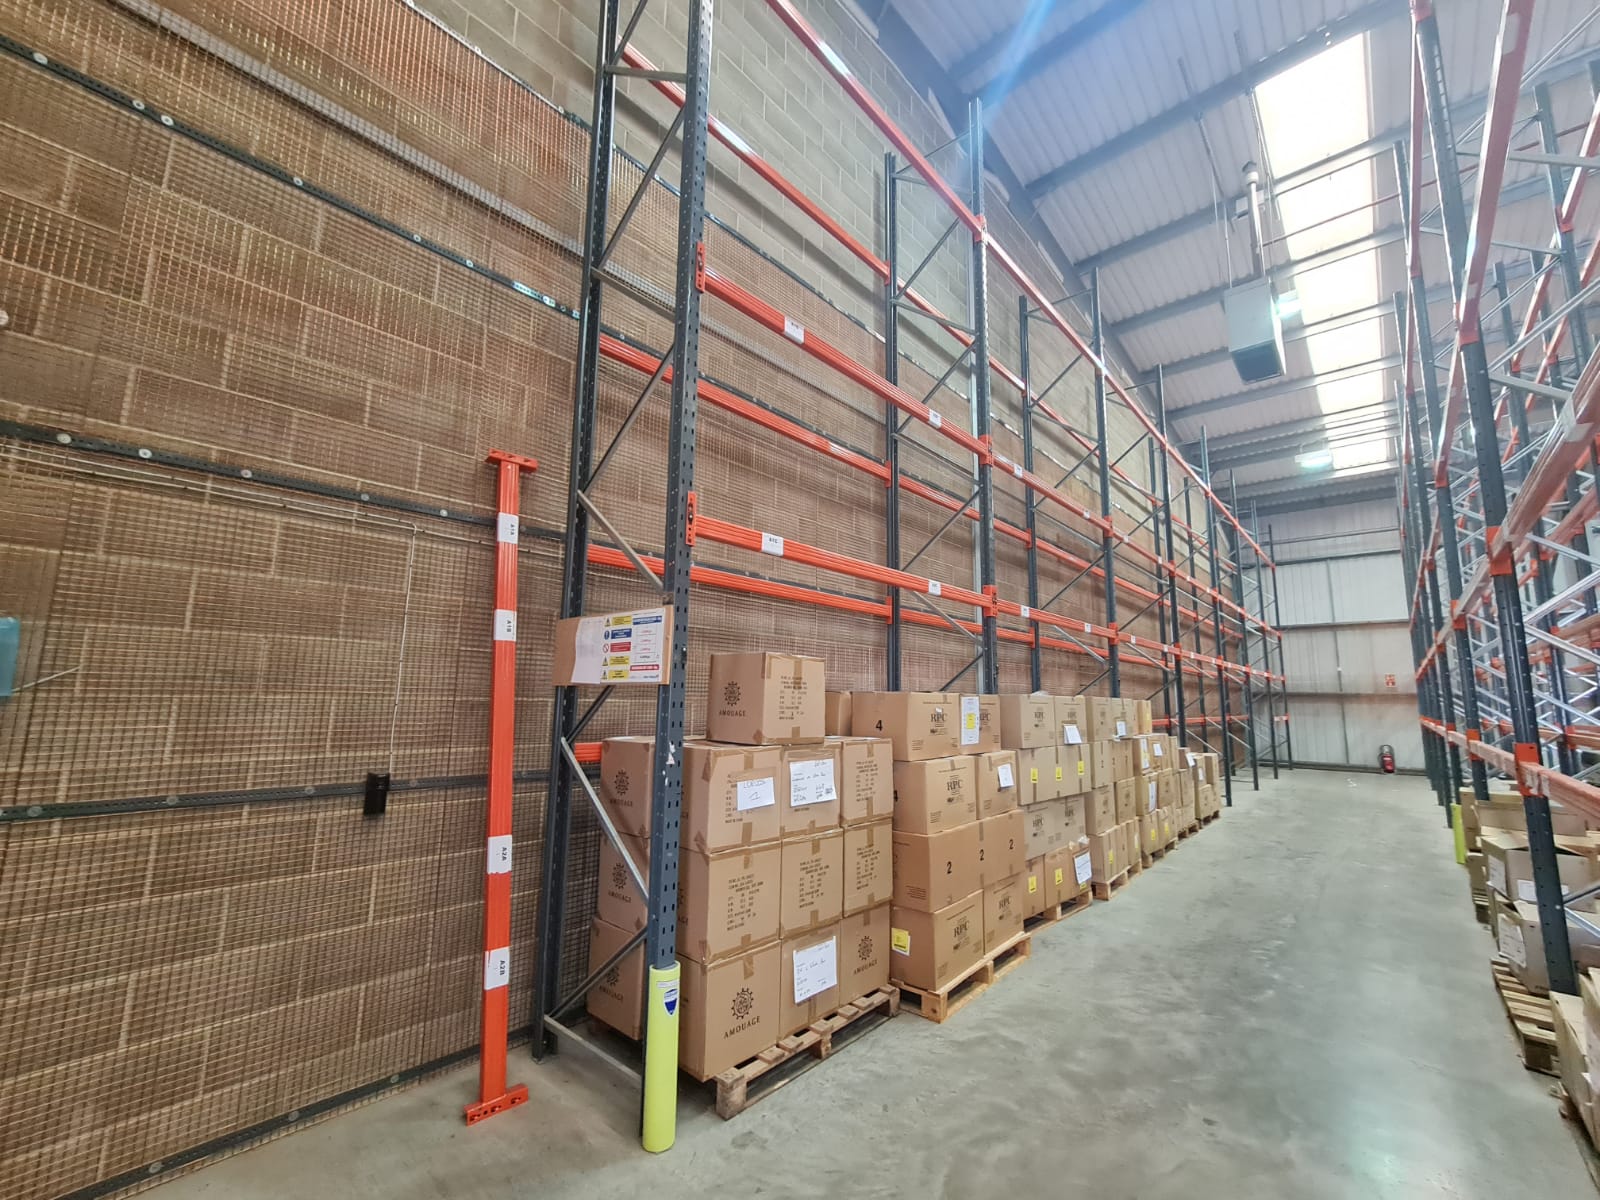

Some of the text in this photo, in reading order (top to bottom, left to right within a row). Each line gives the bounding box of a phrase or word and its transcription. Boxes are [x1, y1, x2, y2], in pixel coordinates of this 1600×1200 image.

[719, 709, 746, 717] AMOUAGE
[930, 713, 948, 723] RPC
[875, 719, 883, 732] 4
[1008, 839, 1014, 850] 2
[979, 849, 985, 861] 2
[946, 861, 952, 874] 2
[954, 920, 970, 938] RPC
[723, 1016, 761, 1039] AMOUAGE
